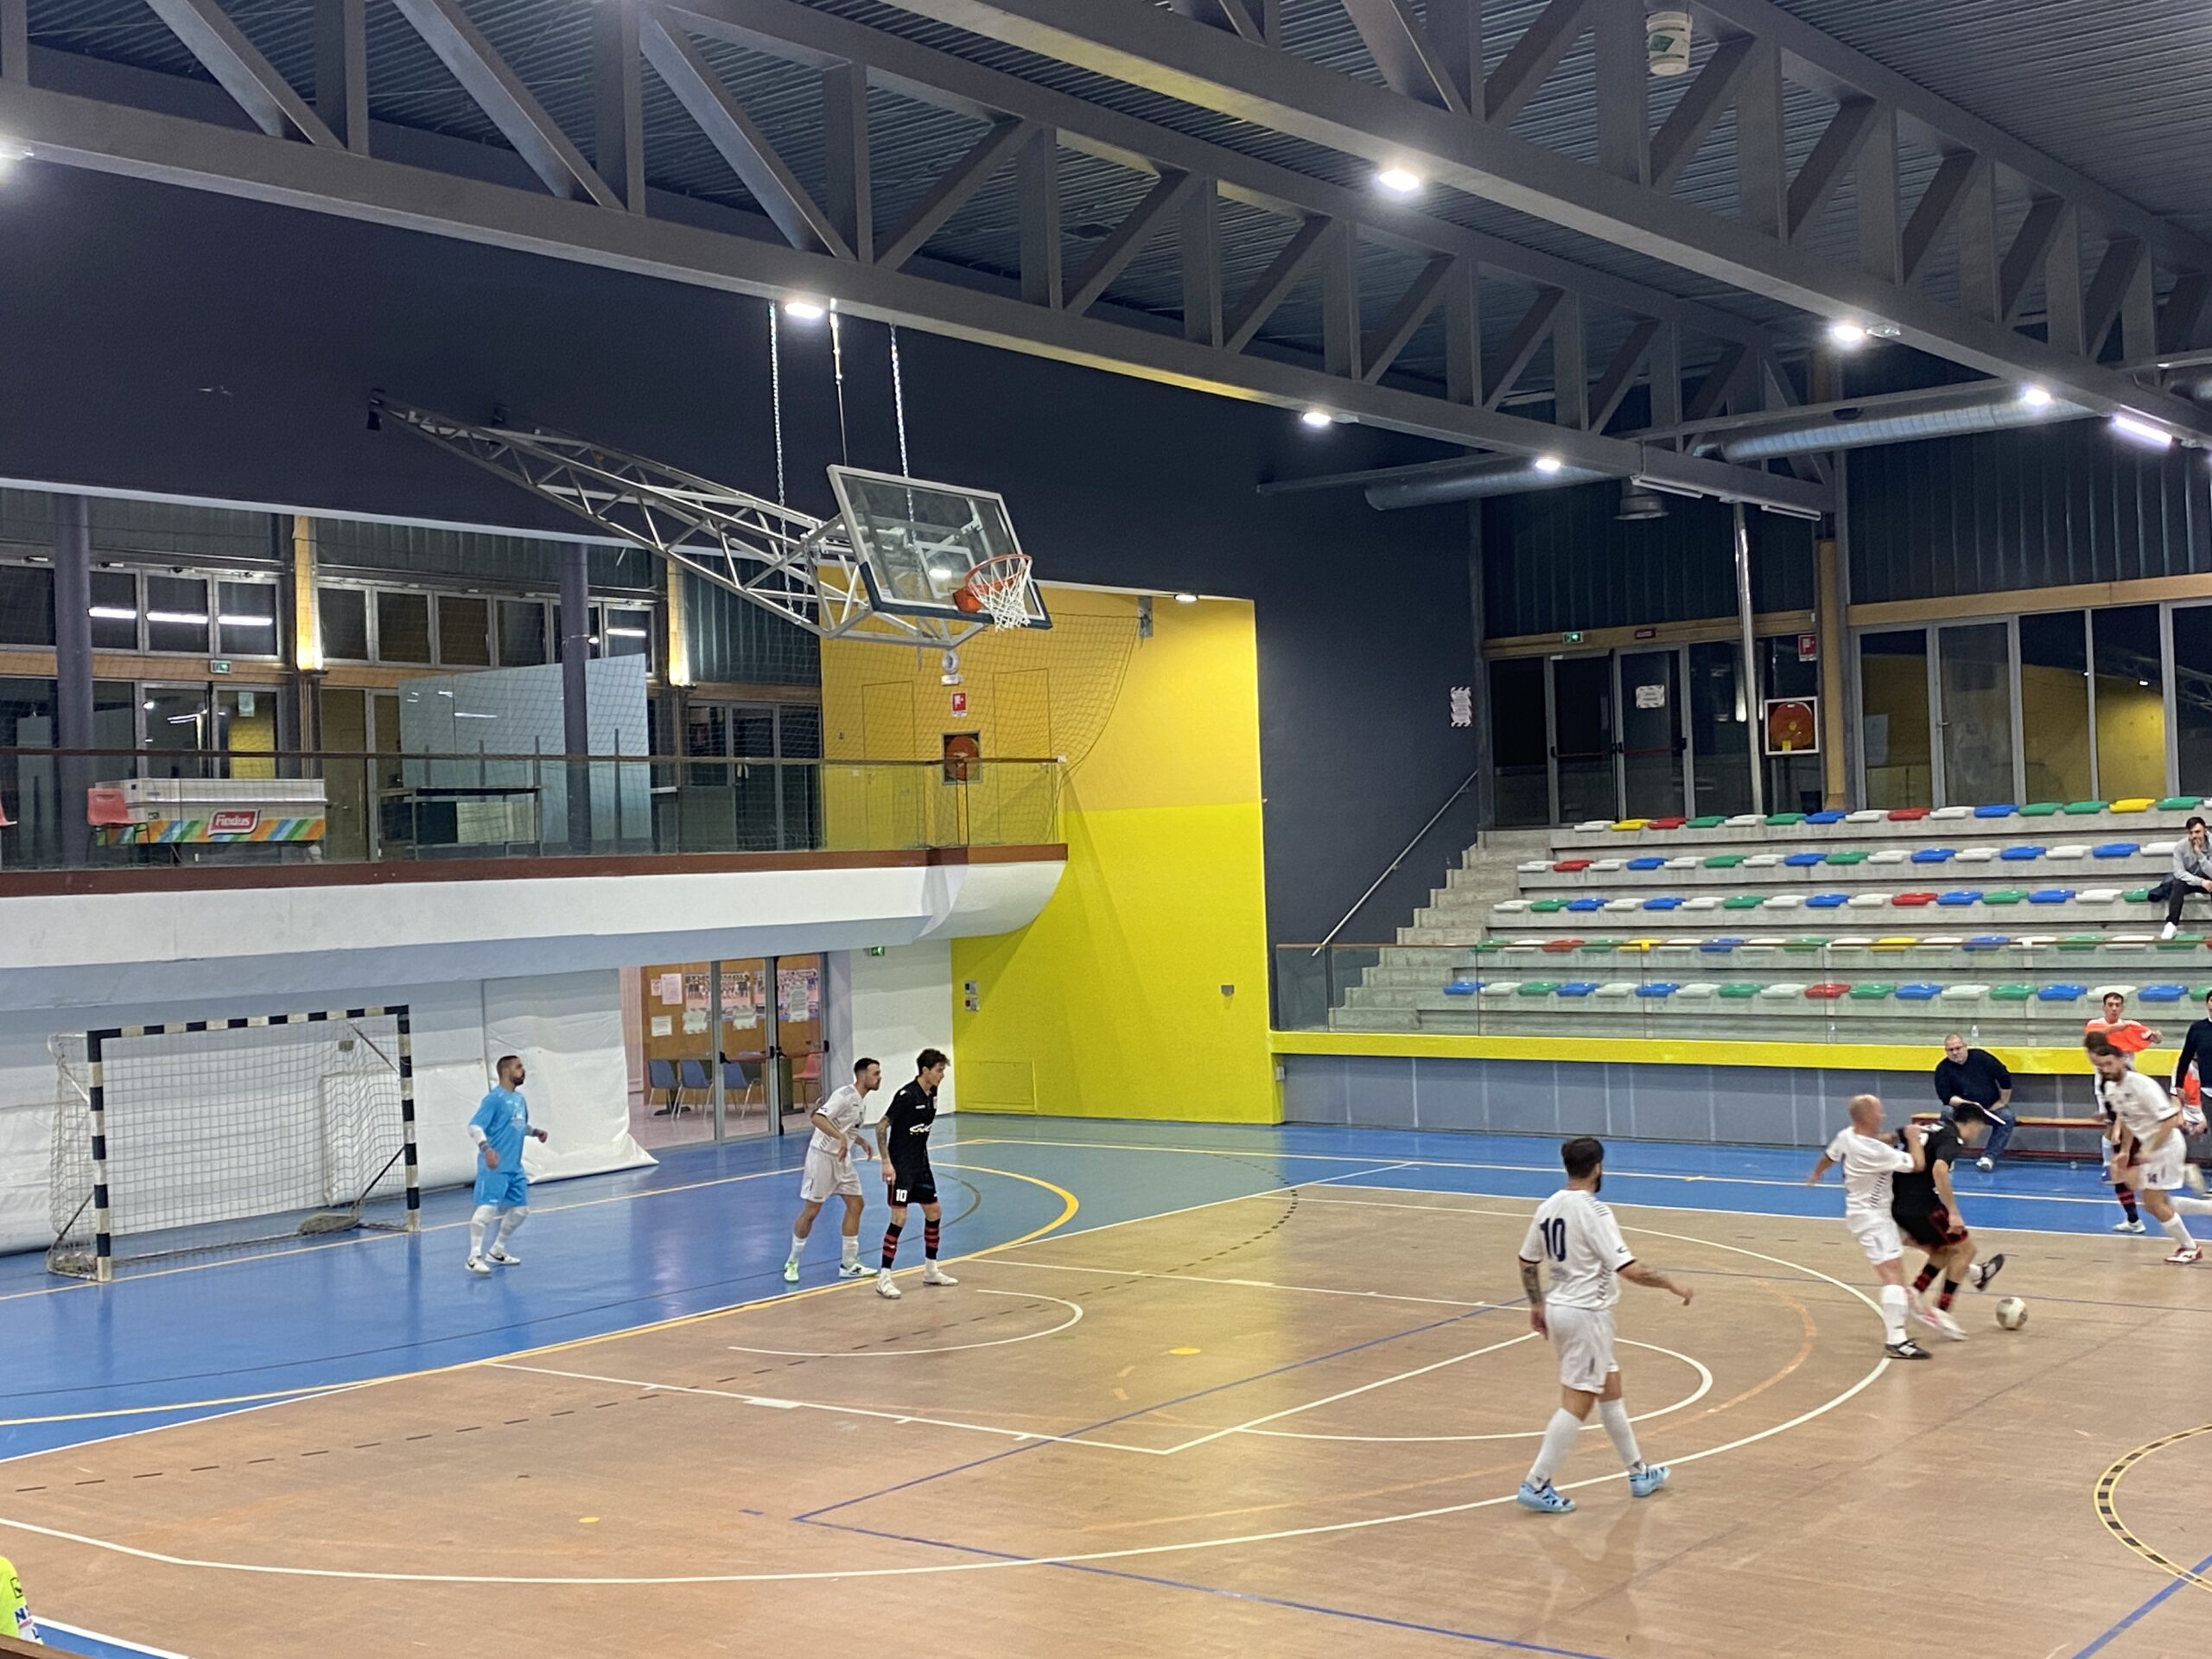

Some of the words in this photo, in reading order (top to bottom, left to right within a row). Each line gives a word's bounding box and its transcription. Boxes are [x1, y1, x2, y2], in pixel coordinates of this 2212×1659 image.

[215, 814, 250, 826] Findus
[895, 1189, 908, 1202] 10
[1539, 1217, 1567, 1262] 10
